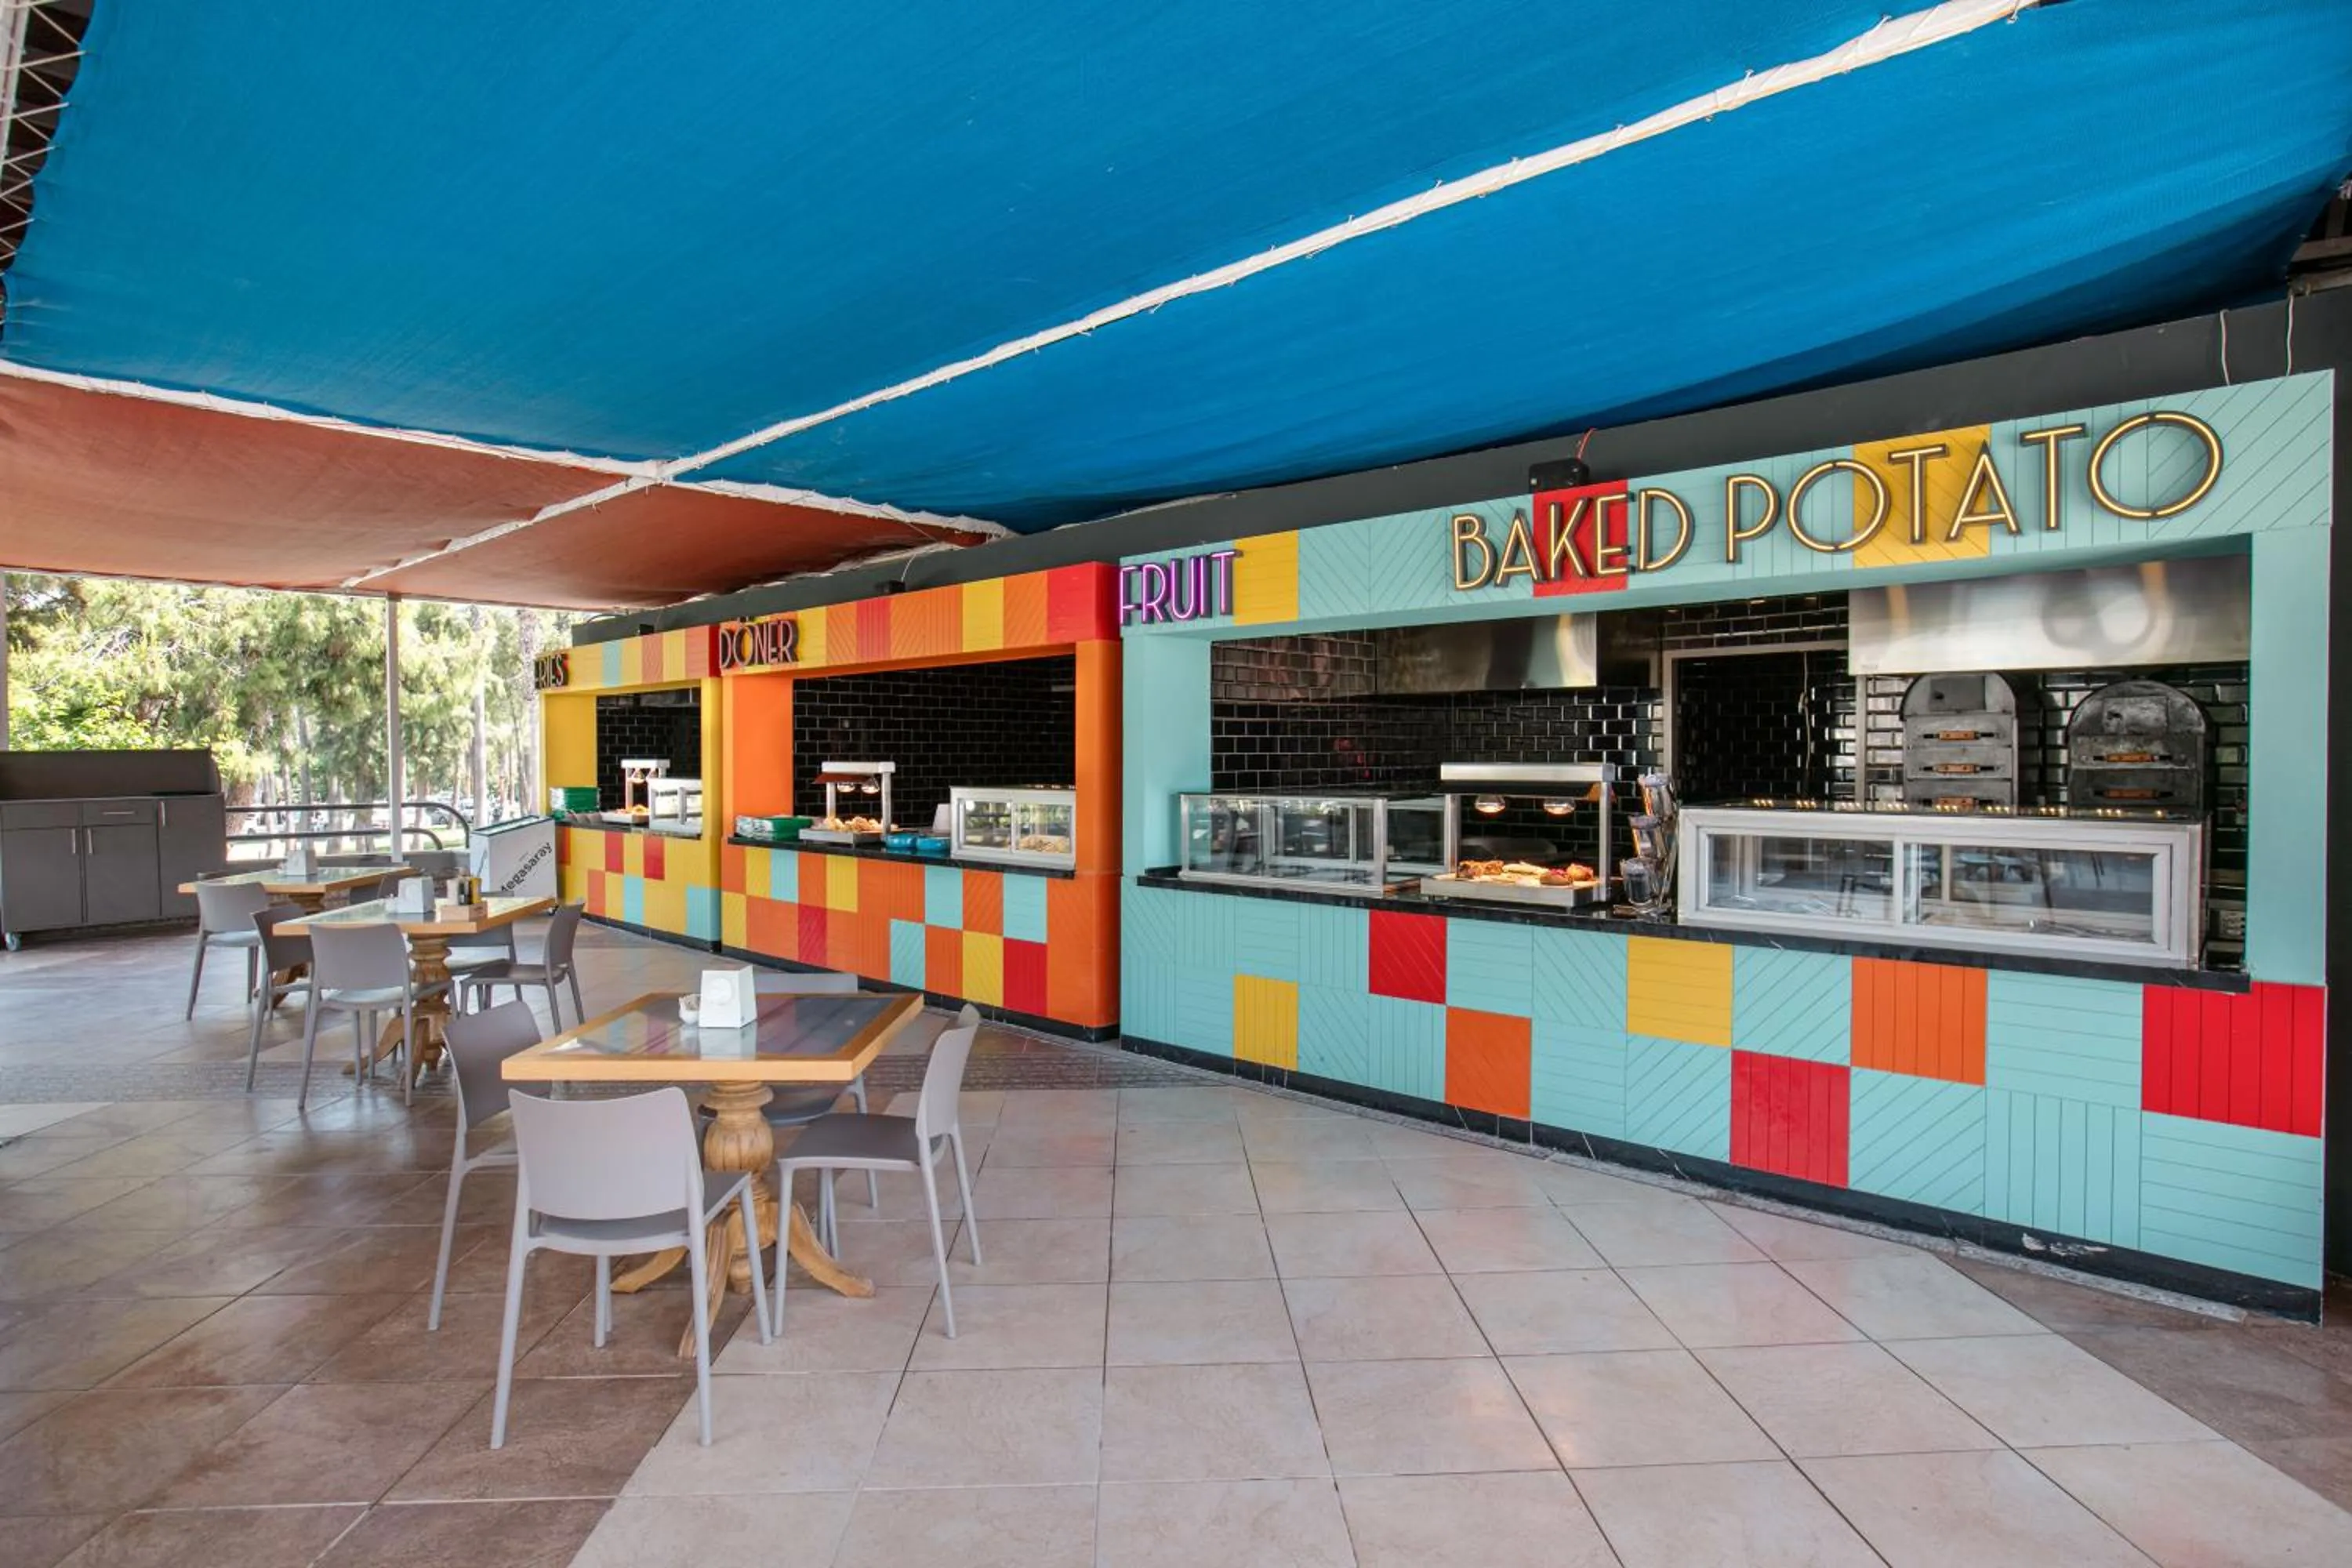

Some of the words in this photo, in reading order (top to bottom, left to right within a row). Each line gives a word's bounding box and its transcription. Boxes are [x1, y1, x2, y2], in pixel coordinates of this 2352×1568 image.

[1453, 488, 1695, 591] BAKED
[1726, 410, 2224, 564] POTATO
[1119, 550, 1242, 626] FRUIT
[719, 615, 797, 670] DÖNER
